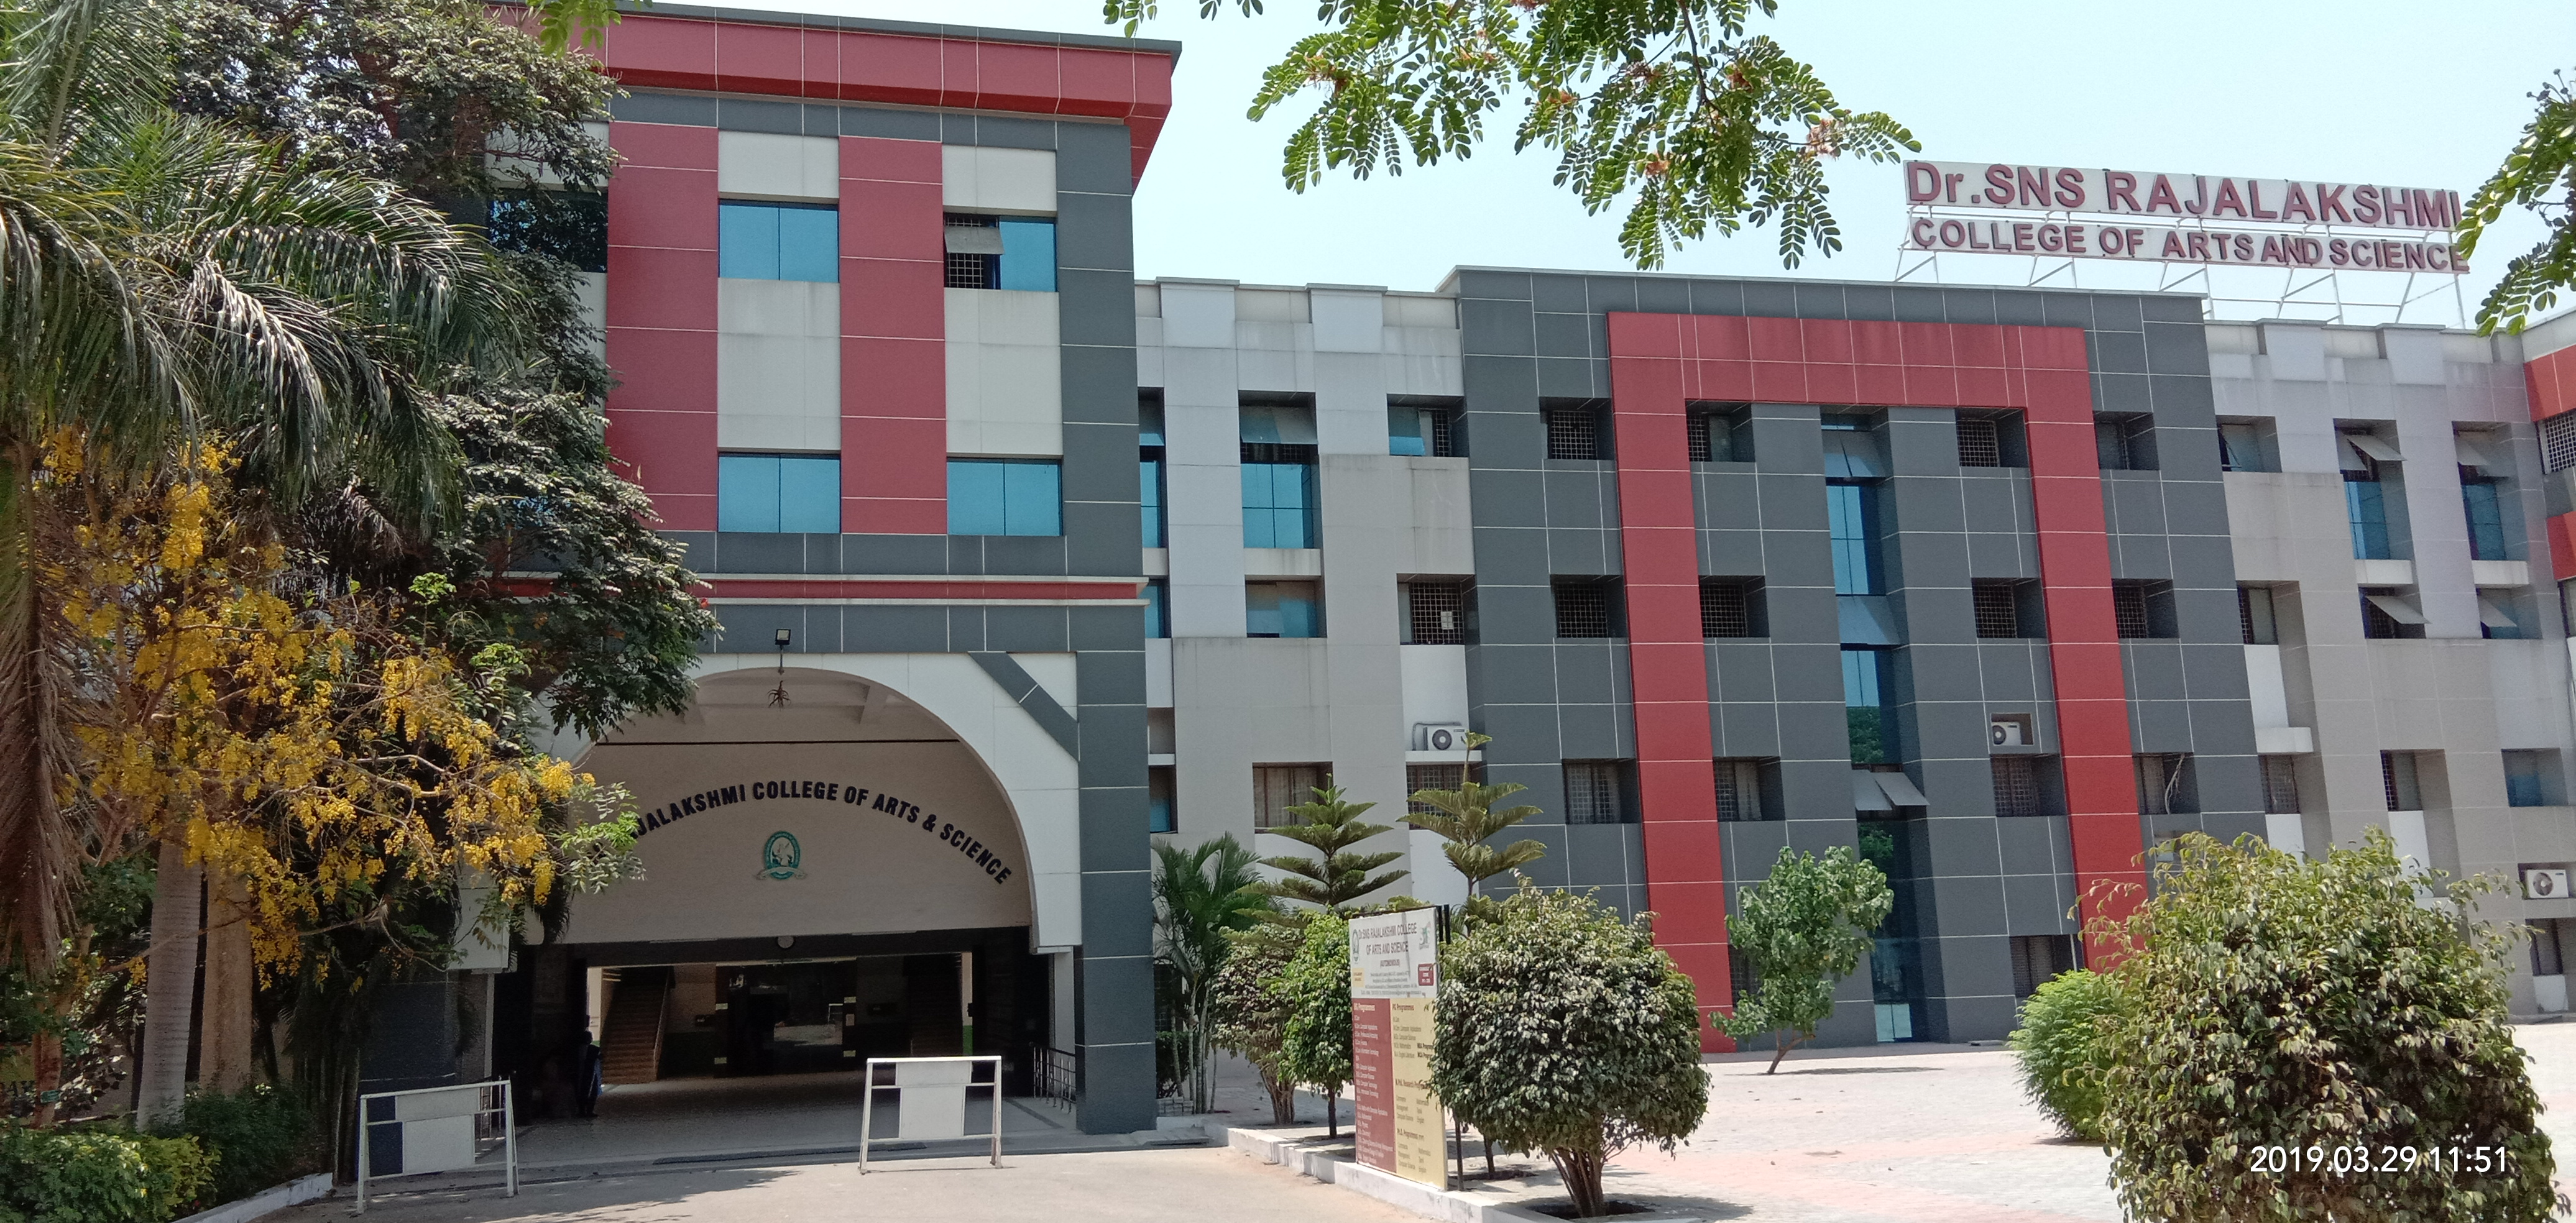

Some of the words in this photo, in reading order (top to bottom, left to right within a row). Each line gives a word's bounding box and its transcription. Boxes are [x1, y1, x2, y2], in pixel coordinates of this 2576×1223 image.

[1908, 162, 2086, 208] Dr.SNS
[2105, 171, 2462, 227] RAJALAKSHMI
[1913, 219, 2086, 252] COLLEGE
[2099, 227, 2144, 255] OF
[2162, 231, 2255, 260] ARTS
[2261, 236, 2323, 264] AND
[2329, 239, 2470, 272] SCIENCE
[630, 784, 745, 838] JALAKSHMI
[753, 781, 838, 800] COLLEGE
[844, 786, 868, 805] OF
[872, 794, 920, 823] ARTS
[922, 814, 936, 833] &
[939, 823, 1012, 885] SCIENCE
[1366, 944, 1371, 955] OF
[1372, 943, 1381, 955] ARTS
[1382, 943, 1390, 954] AND
[1391, 941, 1408, 953] SCIENCE
[1370, 925, 1396, 938] RAJALAKSHMI
[1397, 922, 1417, 935] COLLEGE
